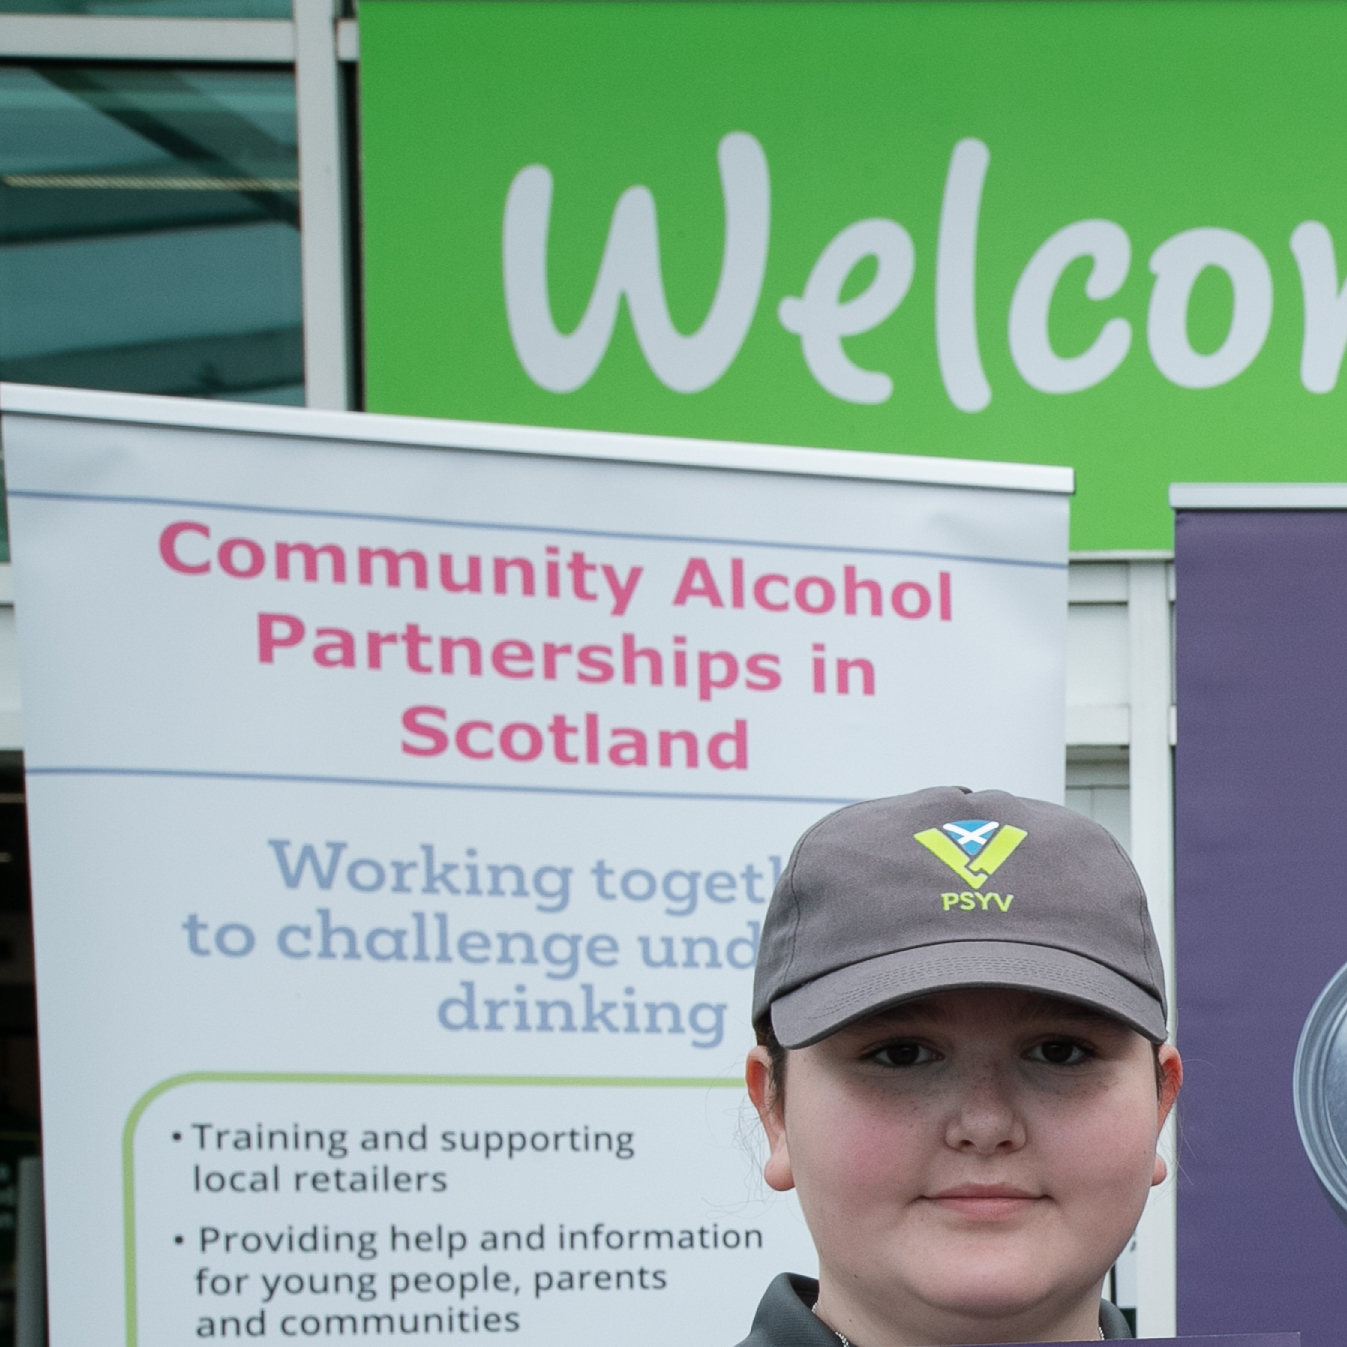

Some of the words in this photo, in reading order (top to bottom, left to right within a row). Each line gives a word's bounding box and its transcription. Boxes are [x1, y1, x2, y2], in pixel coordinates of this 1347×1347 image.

[158, 521, 643, 616] Community
[673, 557, 951, 621] Alcohol
[257, 612, 782, 701] Partnerships
[812, 643, 875, 695] in
[401, 704, 748, 770] Scotland
[267, 838, 574, 914] Working
[591, 855, 781, 917] toget
[939, 891, 1015, 913] PSYV
[181, 913, 256, 958] to
[276, 907, 619, 980] challenge
[437, 980, 728, 1050] drinking
[191, 1123, 348, 1159] Training
[360, 1124, 427, 1152] and
[441, 1125, 635, 1160] supporting
[194, 1164, 279, 1193] local
[294, 1165, 447, 1193] retailers
[200, 1225, 378, 1261] Providing
[390, 1224, 467, 1259] help
[480, 1223, 545, 1252] and
[559, 1223, 763, 1250] information
[195, 1267, 249, 1296] for
[261, 1273, 377, 1303] young
[390, 1265, 520, 1301] people,
[534, 1267, 667, 1299] parents
[196, 1308, 266, 1338] and
[280, 1306, 520, 1337] communities
